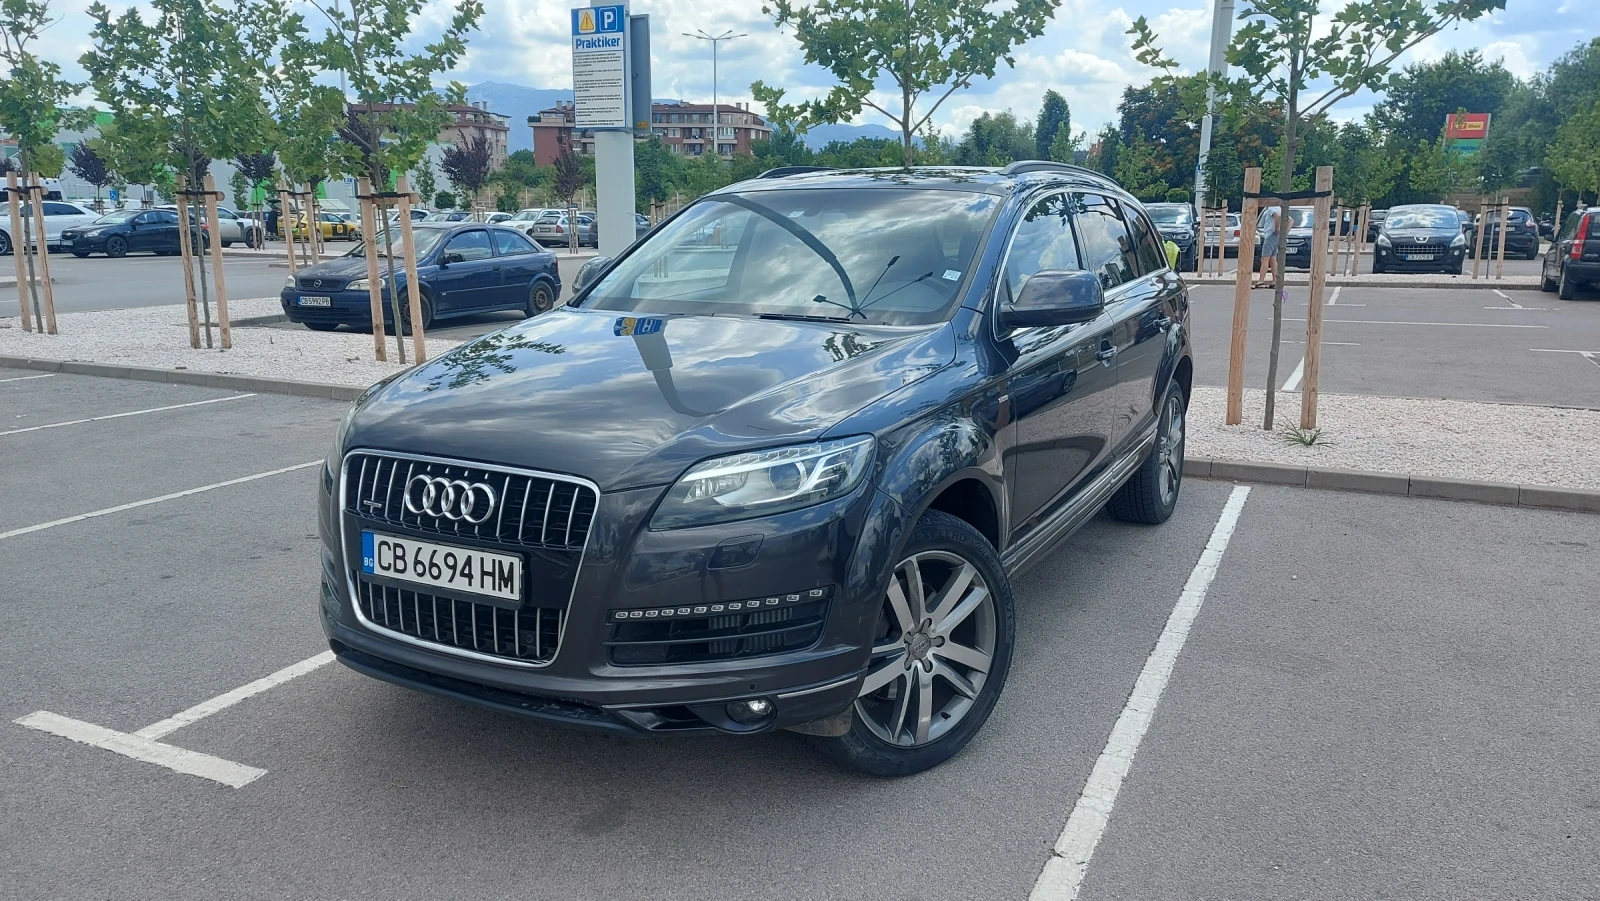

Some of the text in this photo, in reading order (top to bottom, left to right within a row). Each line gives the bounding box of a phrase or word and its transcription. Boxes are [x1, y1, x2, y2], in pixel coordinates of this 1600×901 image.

[604, 11, 614, 28] P
[575, 36, 620, 49] Praktiker
[309, 297, 322, 305] 5992
[363, 556, 374, 567] BG
[377, 540, 515, 595] CB 6694 HM
